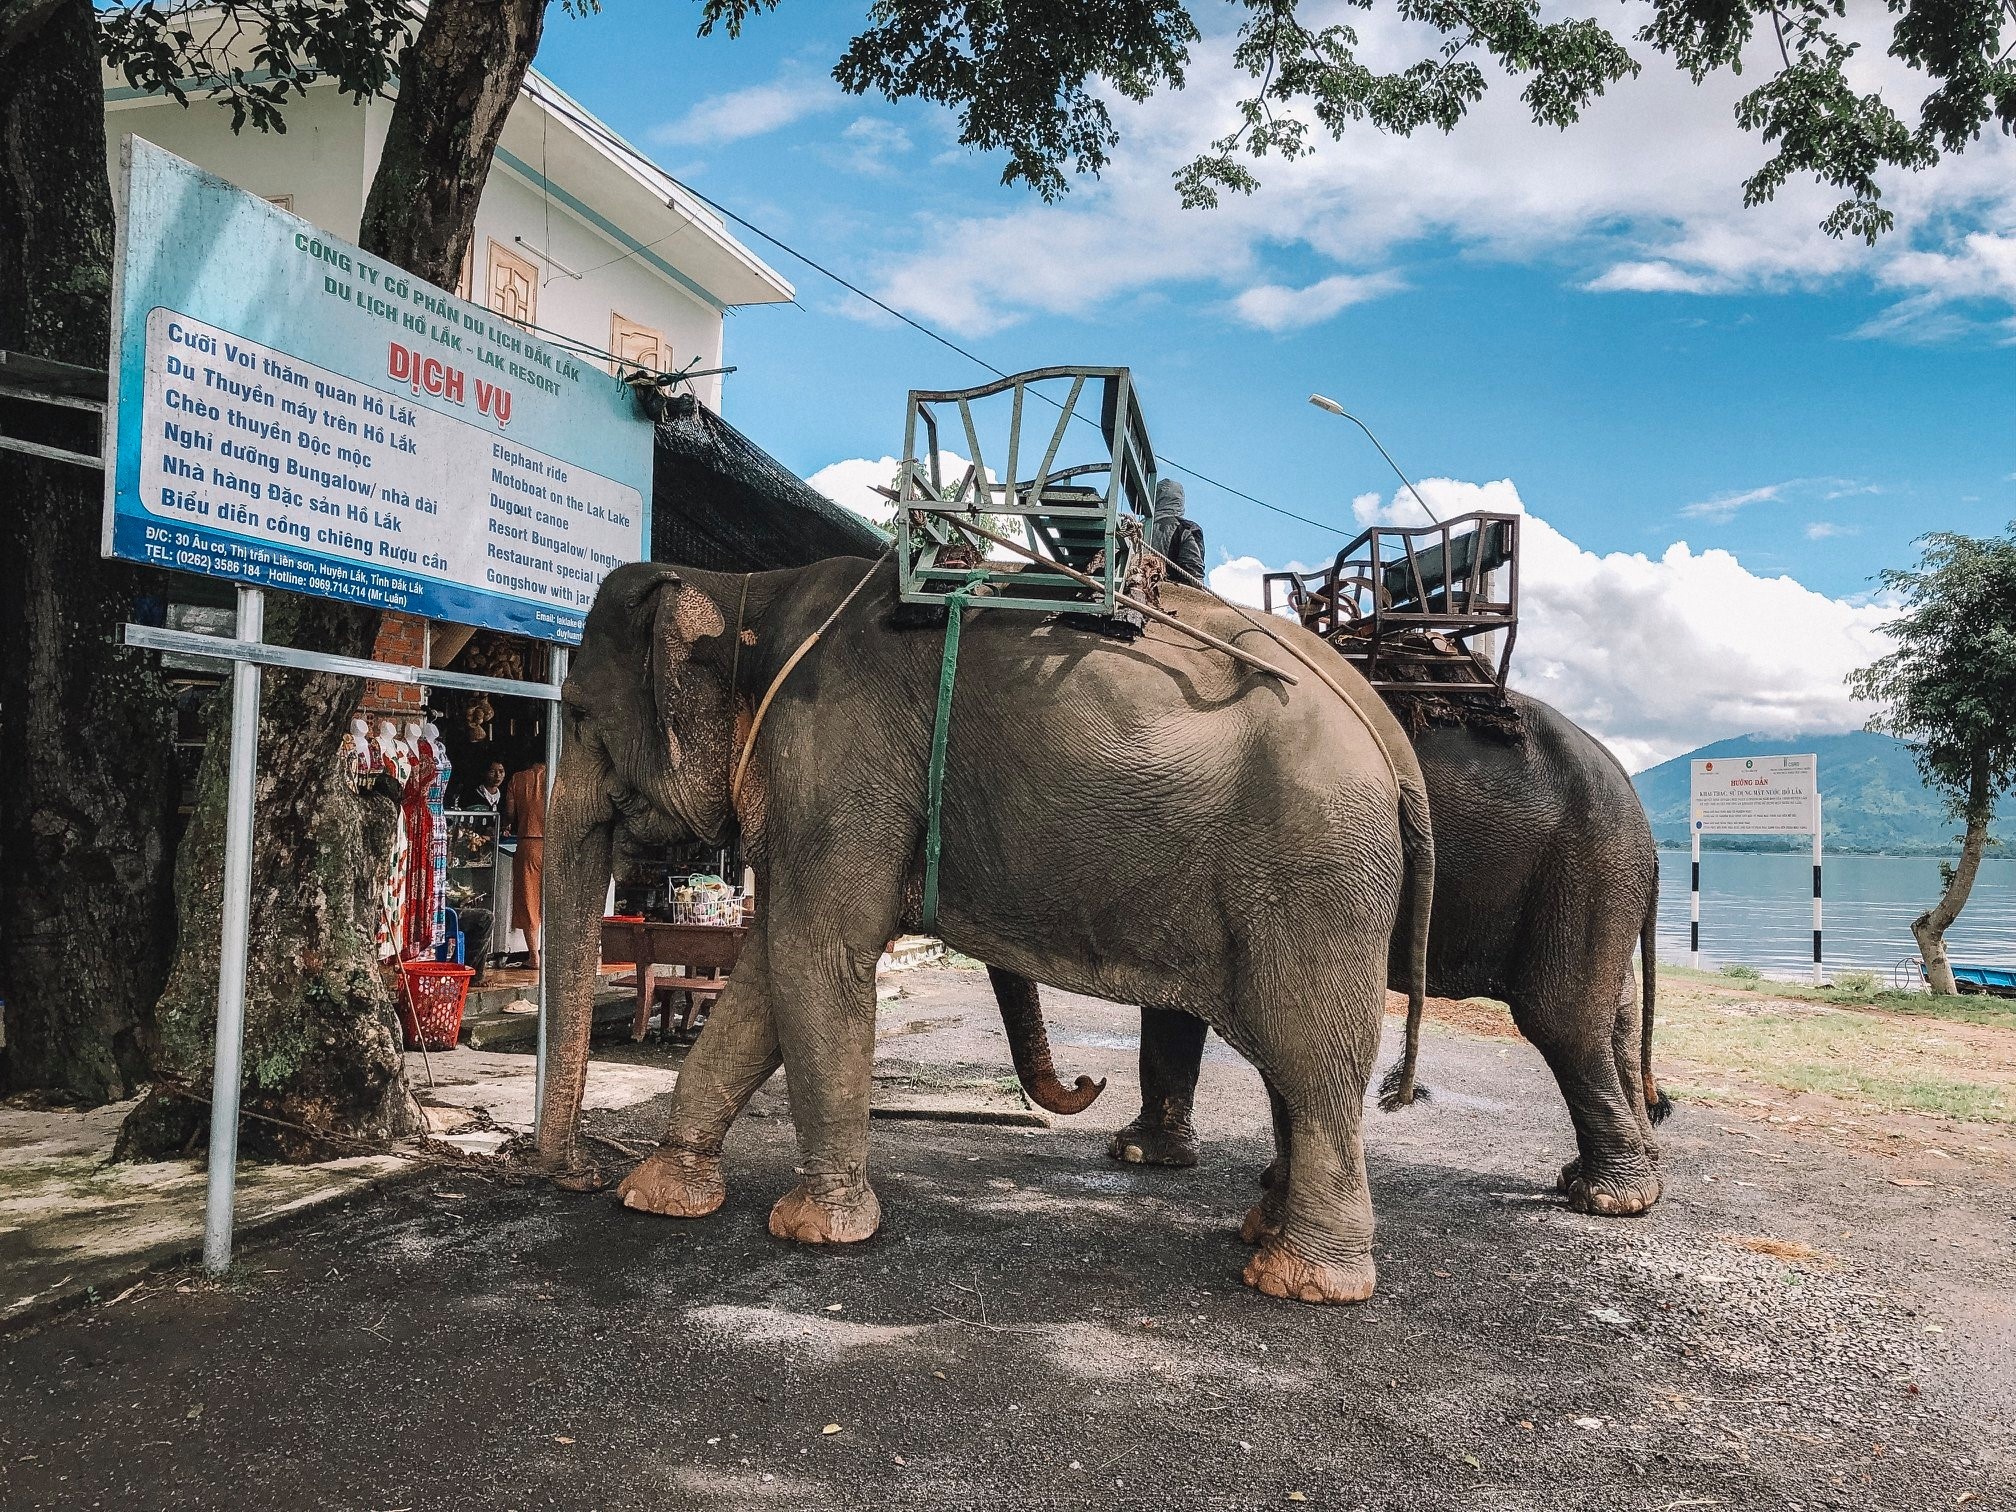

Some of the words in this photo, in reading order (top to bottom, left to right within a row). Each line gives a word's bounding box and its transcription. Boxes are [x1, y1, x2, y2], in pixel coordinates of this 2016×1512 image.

[295, 233, 351, 274] CÔNG
[357, 262, 378, 284] TY
[385, 276, 409, 298] CỔ
[413, 290, 459, 323] PHẦN
[464, 314, 484, 335] DU
[488, 327, 520, 353] LỊCH
[325, 276, 350, 301] DU
[357, 291, 397, 323] LỊCH
[403, 312, 426, 335] HỒ
[477, 347, 504, 371] LAK
[509, 362, 560, 396] RESORT
[168, 323, 216, 356] Cưỡi
[224, 343, 256, 370] Voi
[263, 358, 308, 389] thăm
[315, 380, 357, 406] quan
[363, 394, 384, 415] Hồ
[389, 404, 416, 428] Lắk
[203, 367, 275, 407] Thuyền
[281, 398, 317, 424] máy
[323, 410, 357, 435] trên
[364, 423, 384, 444] Hồ
[390, 432, 416, 455] Lắk
[389, 341, 465, 404] DỊCH
[474, 378, 512, 428] VỤ
[165, 388, 219, 421] Chèo
[226, 408, 292, 443] thuyền
[298, 430, 331, 455] Độc
[337, 446, 371, 468] mộc
[492, 442, 543, 475] Elephant
[546, 465, 567, 483] ride
[163, 454, 204, 482] Nhà
[213, 467, 261, 499] hàng
[267, 483, 303, 507] Đặc
[309, 495, 340, 517] sản
[347, 503, 368, 524] Hồ
[374, 511, 402, 532] Lắk
[164, 421, 213, 451] Nghỉ
[220, 439, 279, 473] dưỡng
[287, 457, 377, 498] Bungalow/
[381, 488, 410, 507] nhà
[415, 497, 438, 515] dài
[491, 467, 547, 499] Motoboat
[550, 492, 563, 505] on
[566, 495, 584, 512] the
[587, 502, 605, 519] Lak
[608, 509, 630, 528] Lake
[161, 487, 209, 515] Biểu
[217, 502, 259, 527] diễn
[266, 514, 310, 542] cồng
[317, 527, 373, 556] chiêng
[379, 540, 417, 564] Rượu
[422, 551, 448, 571] cần
[488, 517, 527, 542] Resort
[531, 530, 587, 559] Bungalow/
[590, 548, 625, 568] longho
[490, 493, 532, 519] Dugout
[536, 510, 569, 530] canoe
[145, 526, 172, 543] Đ/C:
[175, 533, 190, 546] 30
[192, 533, 208, 551] Âu
[210, 543, 227, 556] cơ,
[230, 544, 247, 561] Thị
[249, 548, 270, 563] trấn
[273, 553, 294, 567] Liên
[297, 560, 317, 575] sơn,
[319, 563, 348, 579] Huyện
[350, 569, 368, 585] Lắk,
[370, 574, 390, 588] Tỉnh
[391, 578, 407, 592] Đắk
[409, 582, 424, 595] Lắk
[145, 543, 173, 561] TEL:
[176, 549, 212, 570] (0262)
[214, 557, 240, 573] 3586
[242, 563, 260, 577] 184
[268, 567, 306, 587] Hotline:
[309, 576, 366, 598] 0969.714.714
[367, 588, 382, 601] (Mr
[486, 568, 548, 595] Gongshow
[551, 586, 573, 602] with
[576, 590, 590, 606] jar
[487, 542, 553, 573] Restaurant
[557, 564, 593, 583] special
[535, 610, 556, 622] Email:
